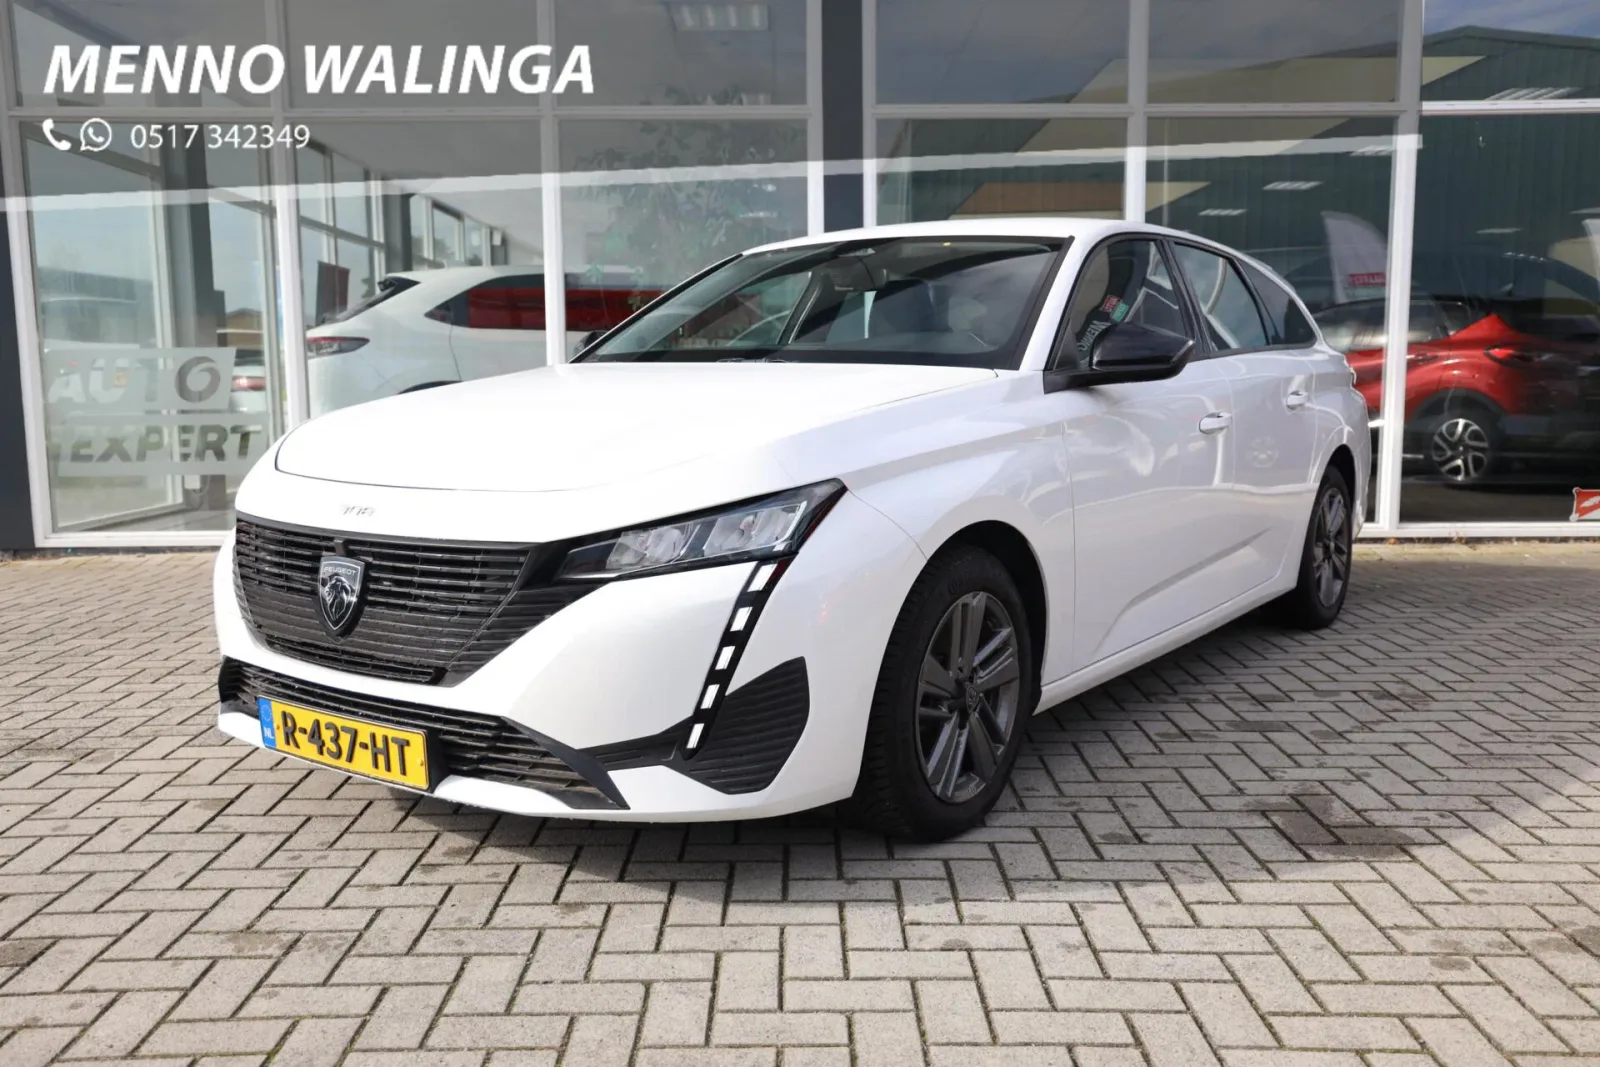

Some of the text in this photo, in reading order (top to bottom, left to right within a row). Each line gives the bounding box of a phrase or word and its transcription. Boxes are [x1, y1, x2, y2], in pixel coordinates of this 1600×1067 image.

[48, 355, 221, 403] AUTO
[70, 423, 262, 463] EXPERT
[323, 566, 357, 576] PEUGEOT
[263, 726, 275, 739] NL
[281, 710, 410, 776] R-437-HT
